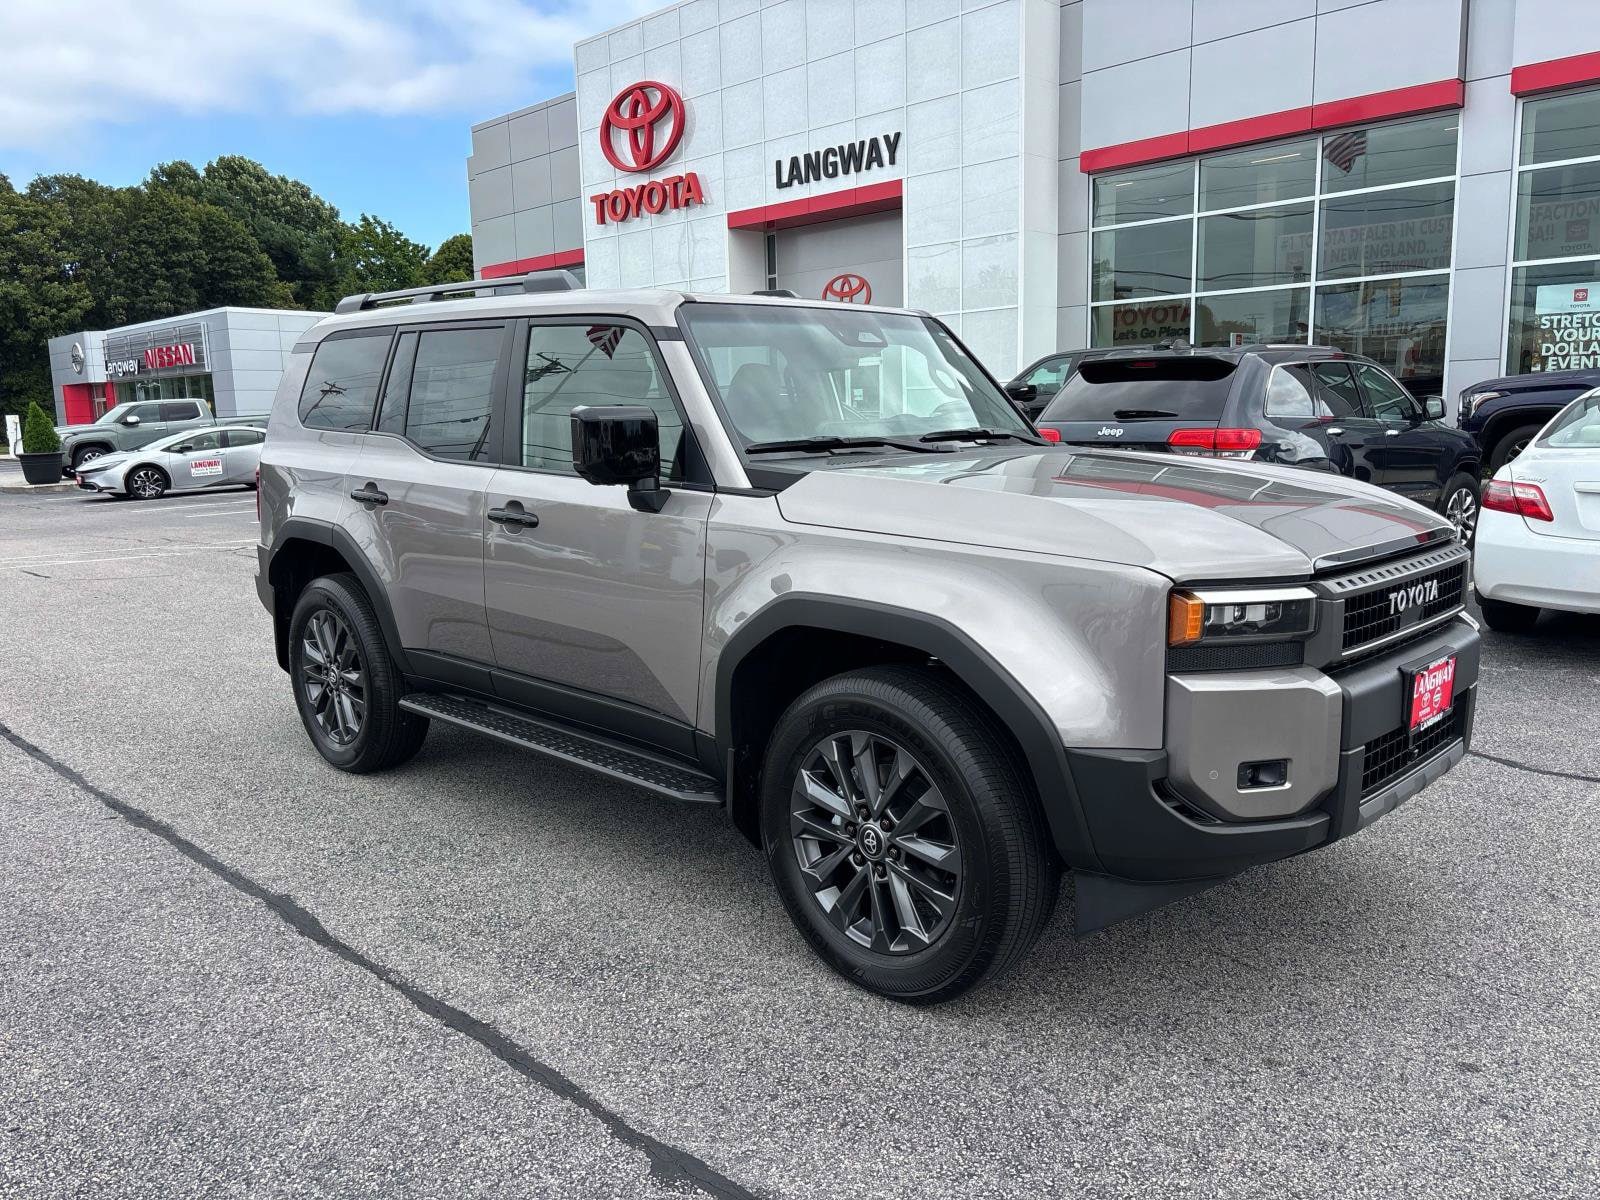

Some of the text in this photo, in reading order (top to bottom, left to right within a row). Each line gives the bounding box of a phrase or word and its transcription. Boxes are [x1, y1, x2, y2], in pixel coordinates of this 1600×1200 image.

[776, 131, 902, 189] LANGWAY
[590, 172, 704, 225] TOYOTA
[1350, 222, 1397, 243] DEALER
[1400, 220, 1416, 237] IN
[1330, 246, 1360, 262] NEW
[1114, 303, 1191, 328] TOYOTA
[1140, 327, 1157, 339] Go
[1553, 327, 1600, 342] YOUR
[104, 343, 196, 376] Langway NISSAN
[1097, 426, 1124, 438] Jeep
[191, 460, 221, 469] LANGWAY
[1389, 579, 1438, 614] TOYOTA
[1414, 660, 1455, 699] LANGWAY
